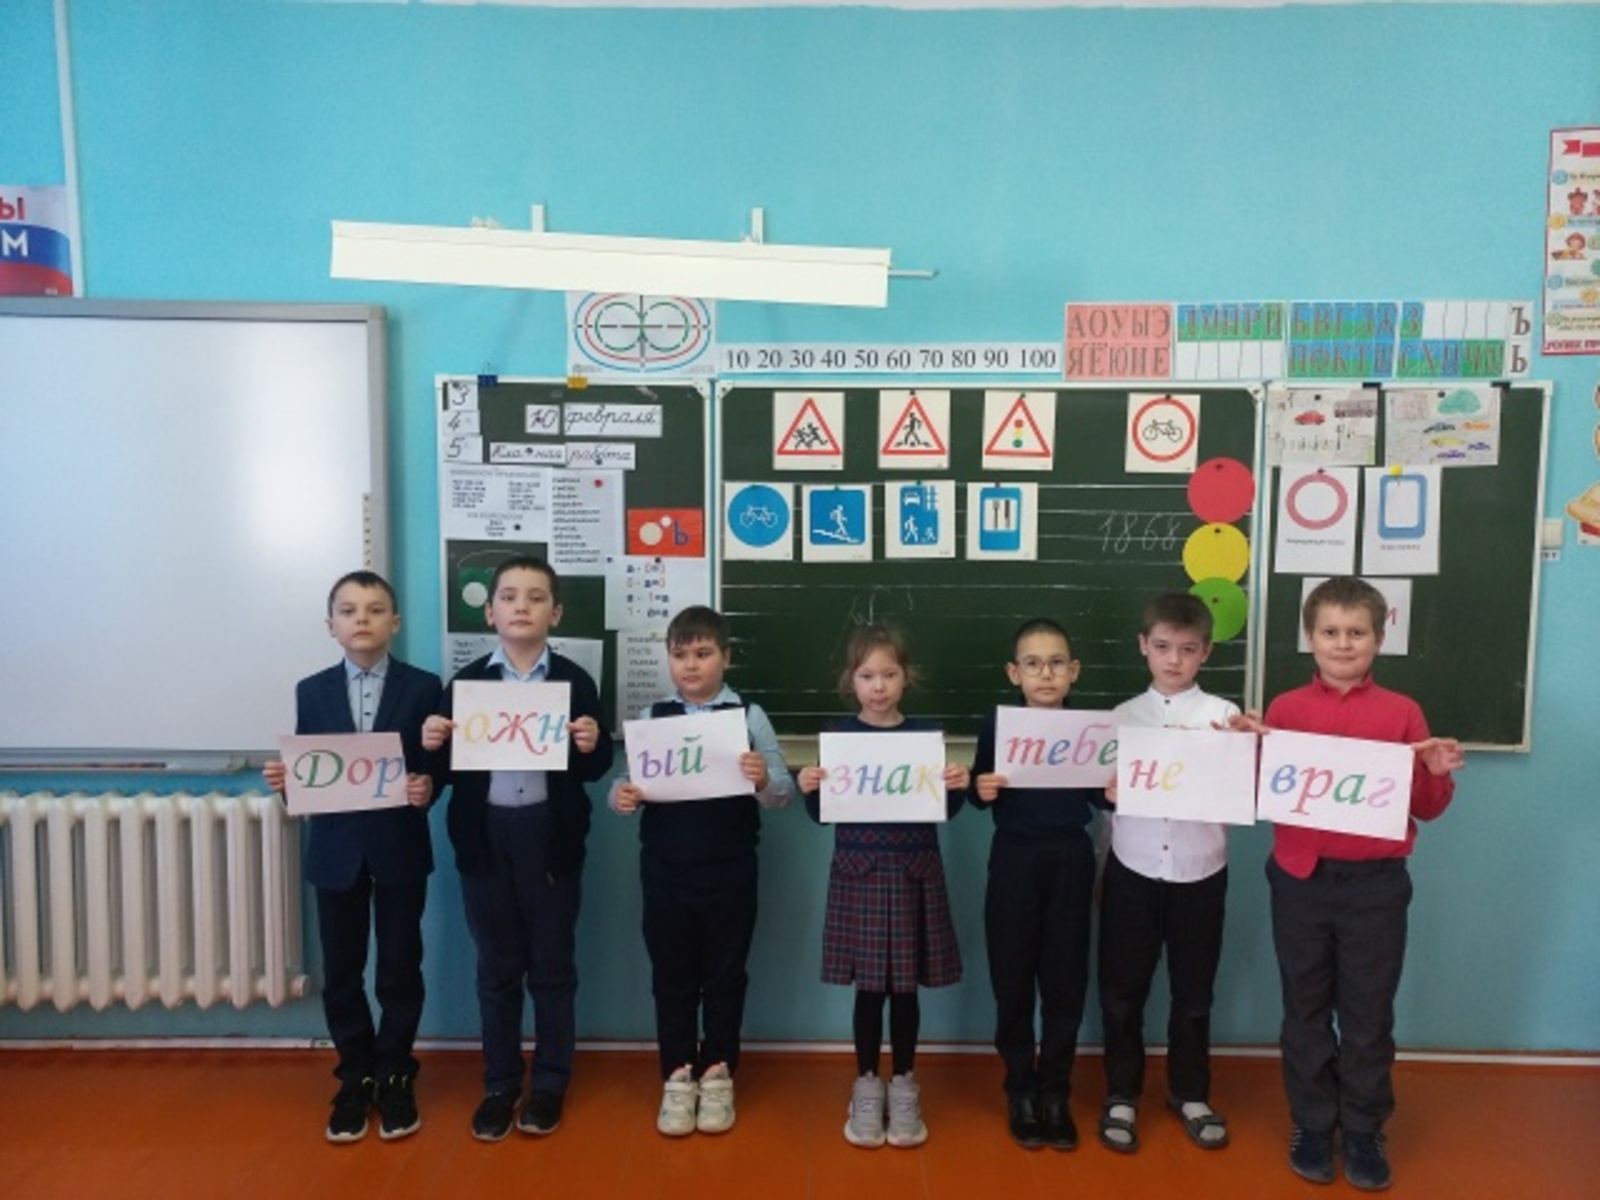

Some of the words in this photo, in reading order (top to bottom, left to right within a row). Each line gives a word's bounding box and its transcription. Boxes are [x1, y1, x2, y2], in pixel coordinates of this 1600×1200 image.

[727, 349, 749, 368] 10
[757, 349, 783, 368] 20
[789, 349, 815, 368] 30
[820, 349, 847, 368] 40
[854, 349, 879, 368] 50
[886, 349, 911, 368] 60
[919, 349, 944, 368] 70
[951, 349, 976, 368] 80
[984, 349, 1009, 368] 90
[1019, 349, 1056, 368] 100
[566, 404, 657, 433] февраля
[1100, 513, 1180, 554] 1868
[464, 711, 568, 755] ожн
[1007, 724, 1118, 765] тебе
[294, 749, 405, 798] Дор
[638, 735, 706, 779] ый
[1128, 758, 1185, 792] не
[829, 763, 941, 804] знак
[1270, 764, 1396, 815] враг
